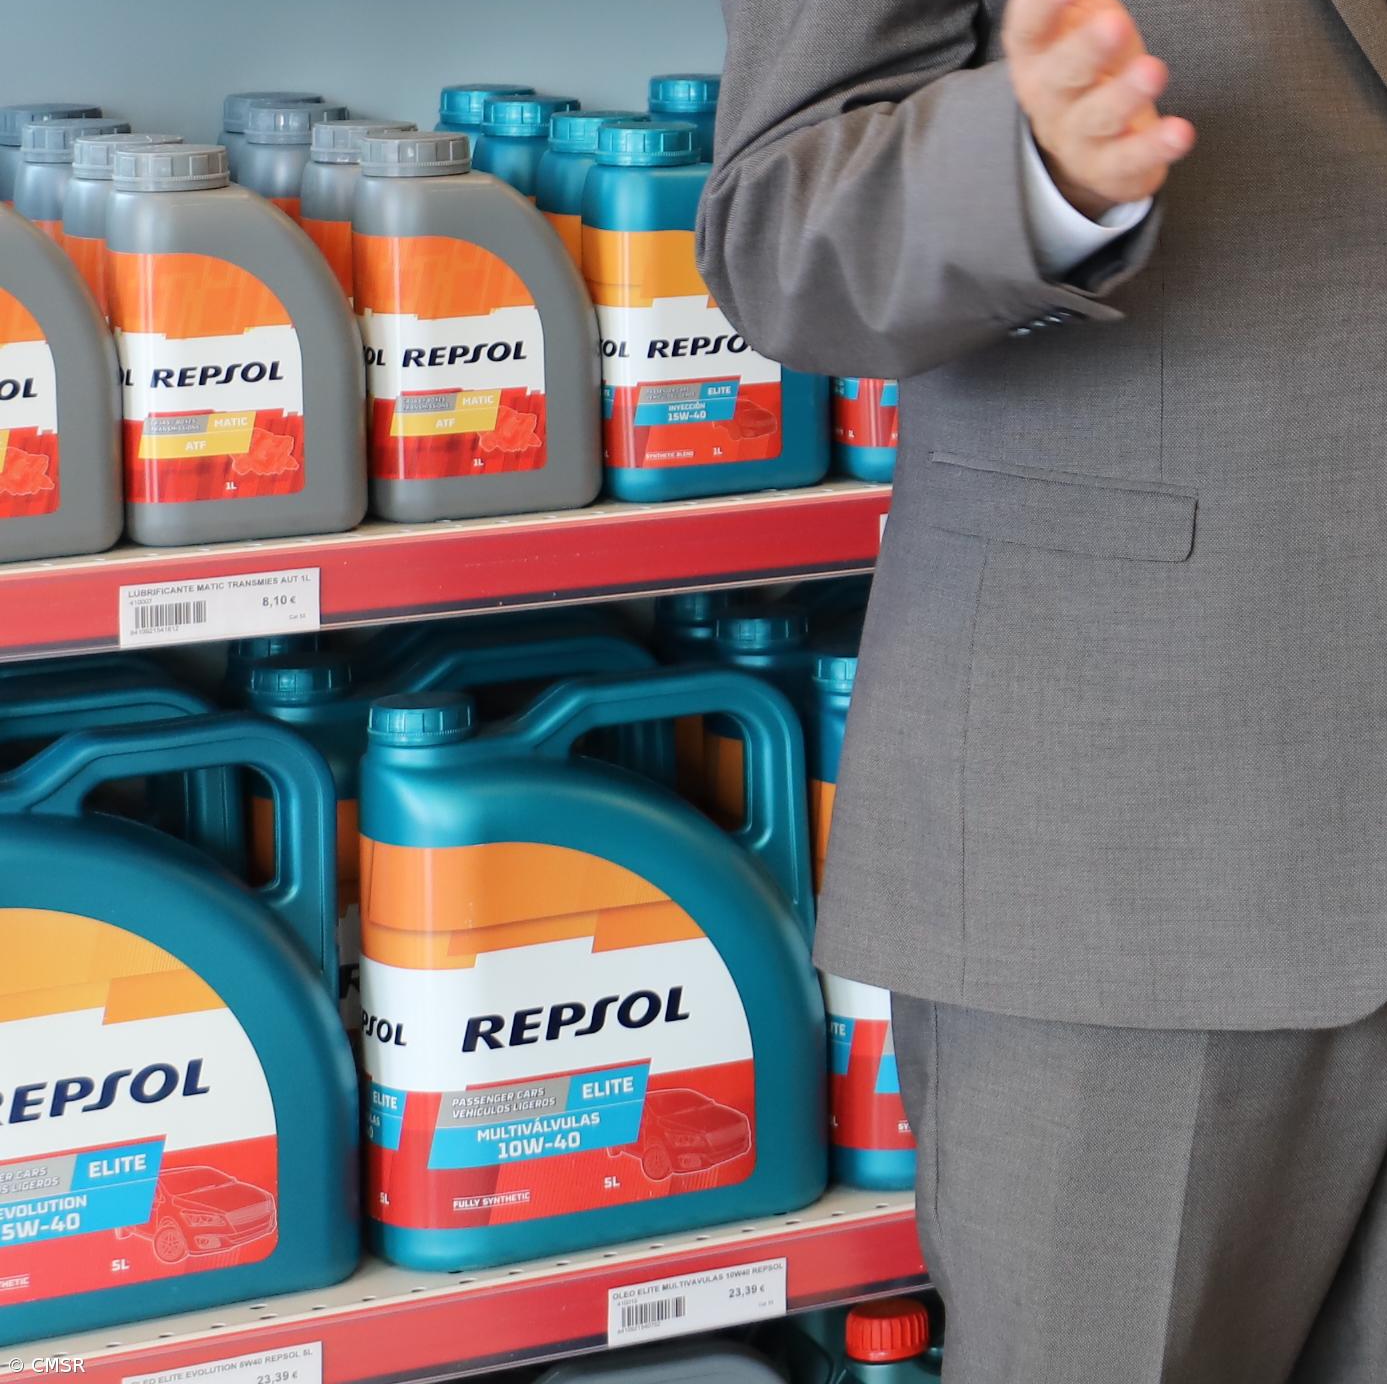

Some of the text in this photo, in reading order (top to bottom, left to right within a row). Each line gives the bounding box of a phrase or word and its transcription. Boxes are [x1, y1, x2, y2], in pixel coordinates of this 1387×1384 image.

[402, 341, 527, 367] REPSOL
[150, 361, 284, 388] REPSOL
[462, 395, 493, 405] MATIC
[708, 386, 731, 395] ELITE
[214, 418, 247, 427] MATIC
[436, 418, 455, 428] ATF
[668, 410, 706, 421] 15W-40
[185, 441, 206, 451] ATF
[128, 576, 298, 598] LUBRIFICANTE MATIC AUT
[263, 595, 287, 608] 8,10
[461, 986, 691, 1054] REPSOL
[452, 1076, 634, 1107] PASSENGER CARS ELITE
[453, 1097, 556, 1119] VEHÍCULOS LIGEROS
[477, 1112, 600, 1142] MULTIVÁLVULAS
[498, 1132, 581, 1159] 10W-40
[16, 1154, 147, 1180] CARS ELITE
[13, 1177, 60, 1193] LIGEROS
[604, 1176, 620, 1188] 5L
[453, 1191, 531, 1210] FULLY SYNTHETIC
[2, 1213, 80, 1241] 5W-40
[111, 1259, 129, 1271] 5L
[613, 1263, 783, 1300] OLEO ELITE REPSOL
[729, 1284, 758, 1298] 23,39
[186, 1351, 301, 1379] EVOLUTION REPSOL
